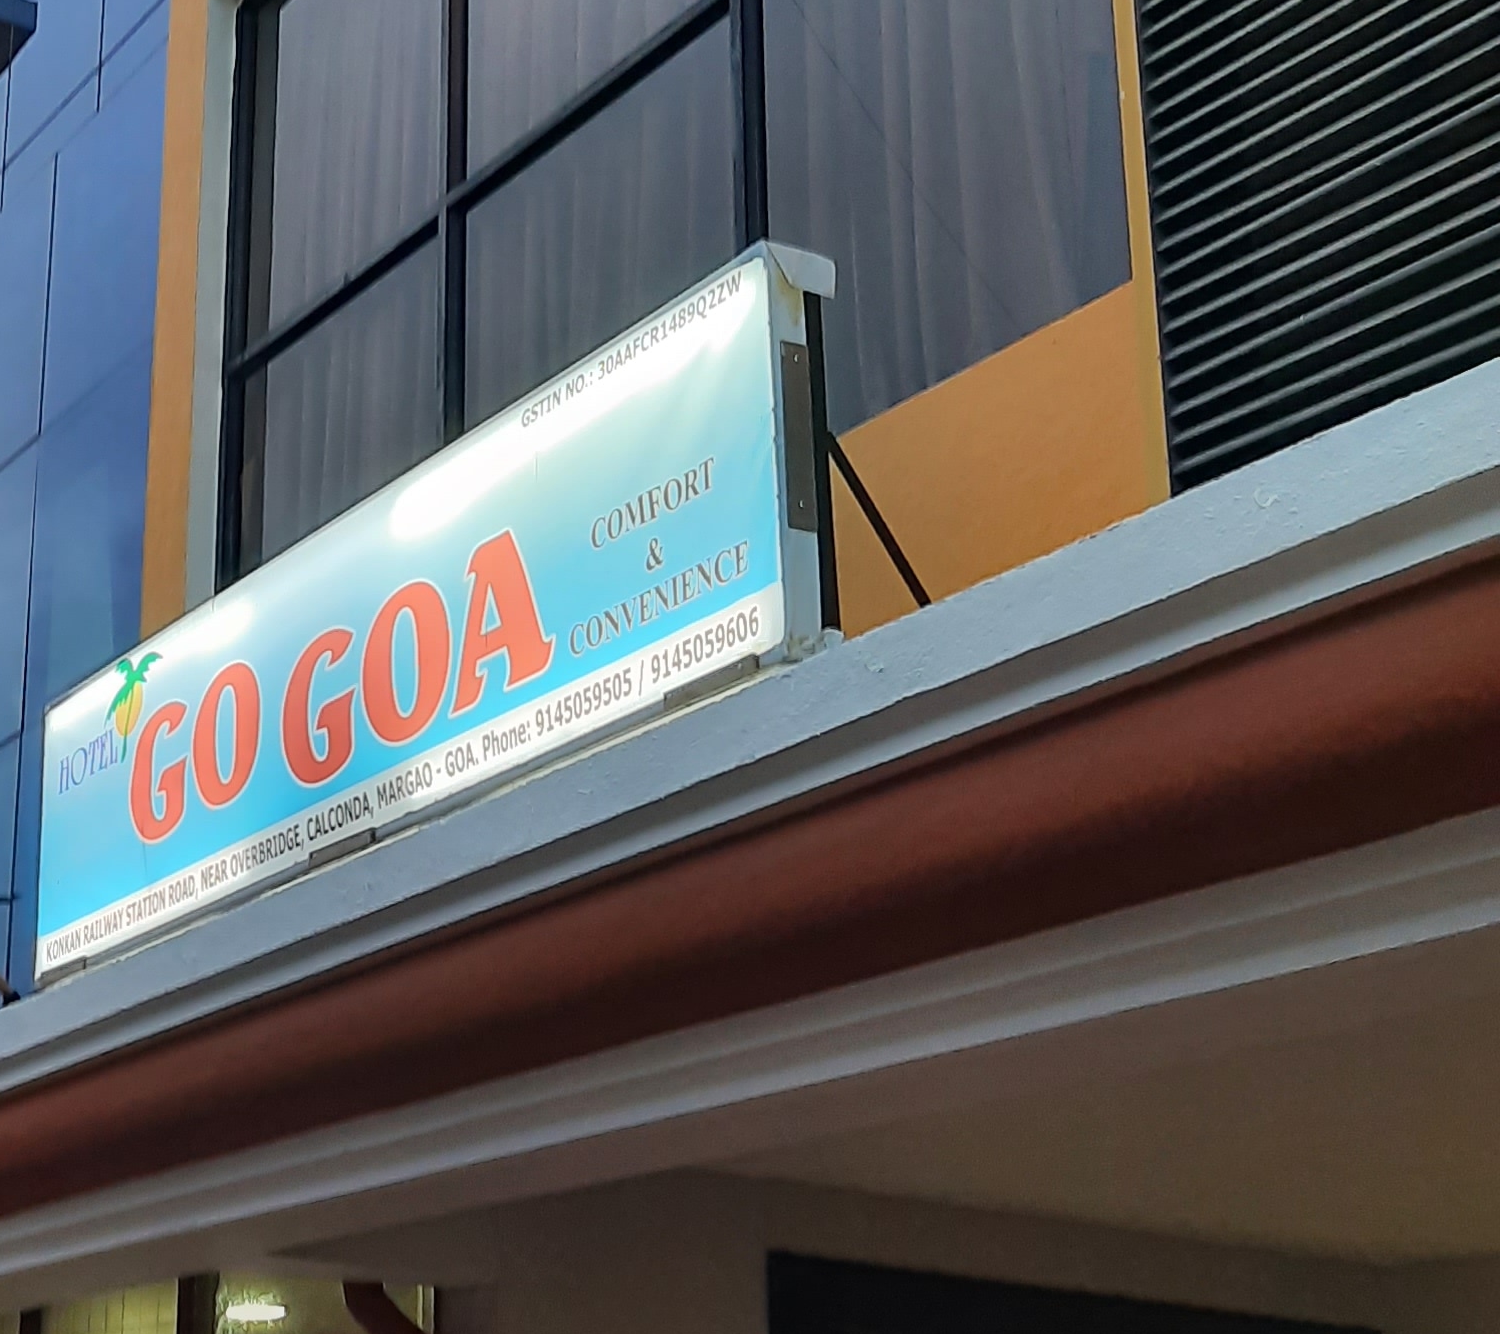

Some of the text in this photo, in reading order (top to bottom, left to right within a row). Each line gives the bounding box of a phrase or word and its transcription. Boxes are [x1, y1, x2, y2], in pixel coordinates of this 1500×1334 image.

[521, 387, 562, 428] GSTIN
[590, 456, 715, 549] COMFORT
[569, 540, 749, 655] CONVENIENCE
[645, 537, 664, 572] &
[129, 528, 556, 844] GO GOA
[46, 927, 82, 962] KONKAN
[83, 909, 125, 945] RAILWAY
[125, 886, 166, 927] STATION
[168, 874, 199, 907] ROAD,
[201, 858, 229, 892] NEAR
[230, 823, 304, 878] OVERBRIDGE,
[306, 791, 374, 842] CALCONDA,
[376, 762, 432, 810] MARGAO
[445, 741, 480, 777] GOA.
[482, 724, 531, 762] Phone:
[535, 666, 633, 736] 9145059505
[638, 659, 645, 697] /
[651, 605, 759, 684] 9145059606
[57, 728, 119, 796] HOTEL
